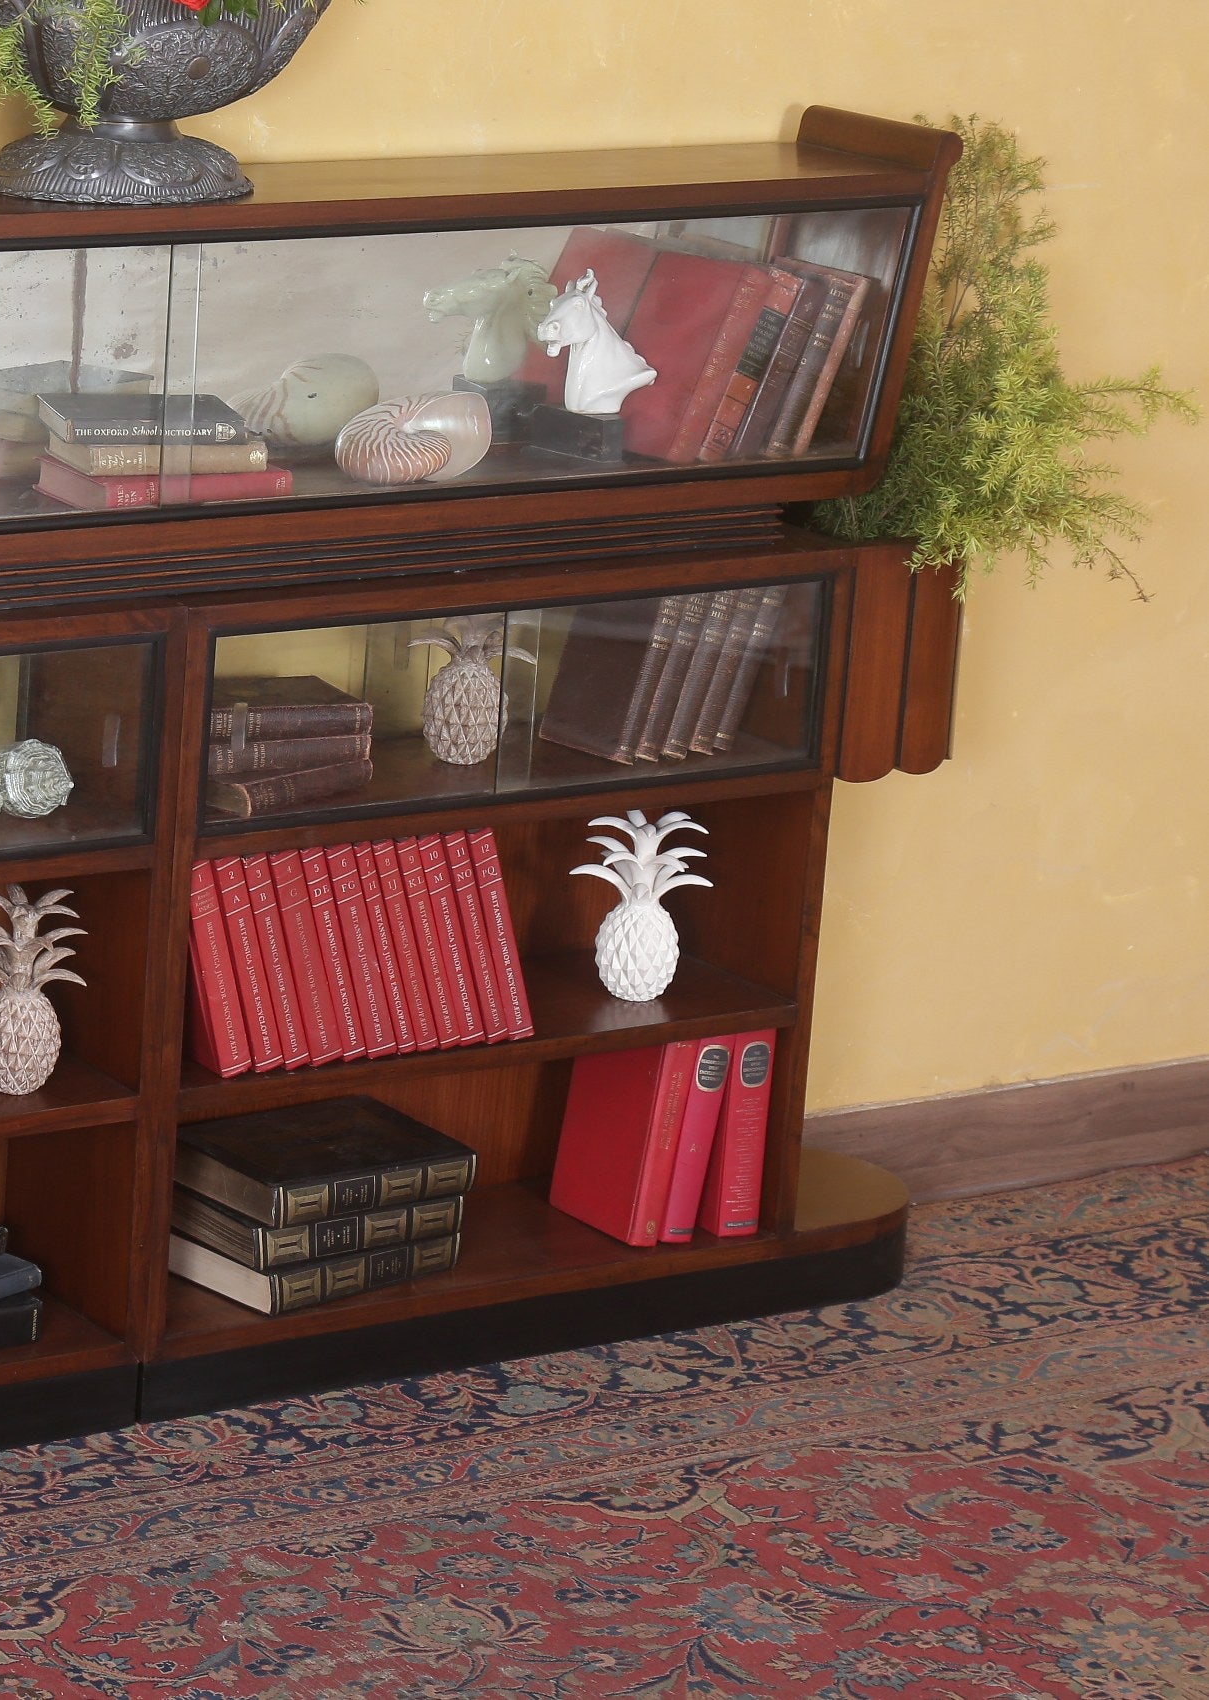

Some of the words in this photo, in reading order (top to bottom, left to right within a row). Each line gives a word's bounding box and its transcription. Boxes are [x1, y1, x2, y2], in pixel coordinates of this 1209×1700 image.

[75, 428, 92, 437] THE
[94, 428, 129, 437] OXFORD
[131, 425, 157, 437] School
[456, 847, 465, 858] 11
[481, 843, 490, 854] 12
[409, 855, 415, 864] 9
[429, 850, 439, 861] 10
[313, 863, 319, 873] 5
[341, 858, 347, 868] 6
[365, 858, 370, 867] 7
[384, 858, 391, 867] 8
[228, 870, 235, 879] 2
[255, 869, 262, 878] 3
[456, 869, 472, 882] NO
[481, 865, 498, 878] PQ
[198, 874, 202, 883] 1
[408, 876, 425, 888] KL
[433, 872, 444, 884] M
[341, 880, 356, 893] FG
[369, 881, 377, 891] H
[388, 879, 397, 891] IJ
[260, 892, 267, 902] B
[313, 885, 330, 898] DE
[233, 895, 241, 904] A
[441, 896, 455, 943] BRITANNICA
[449, 943, 462, 972] JUNIOR
[466, 894, 481, 940] BRITANNICA
[474, 941, 487, 969] JUNIOR
[490, 890, 505, 936] BRITANNICA
[498, 937, 511, 966] JUNIOR
[350, 906, 364, 953] BRITANNICA
[358, 954, 371, 982] JUNIOR
[374, 904, 388, 951] BRITANNICA
[382, 951, 395, 980] JUNIOR
[394, 903, 408, 949] BRITANNICA
[403, 950, 416, 980] JUNIOR
[418, 900, 432, 946] BRITANNICA
[427, 947, 440, 976] JUNIOR
[323, 910, 337, 957] BRITANNICA
[332, 958, 344, 986] JUNIOR
[206, 921, 220, 969] BRITANNICA
[215, 970, 227, 999] JUNIOR
[238, 917, 252, 965] BRITANNICA
[247, 966, 259, 995] JUNIOR
[265, 916, 279, 963] BRITANNICA
[273, 964, 286, 993] JUNIOR
